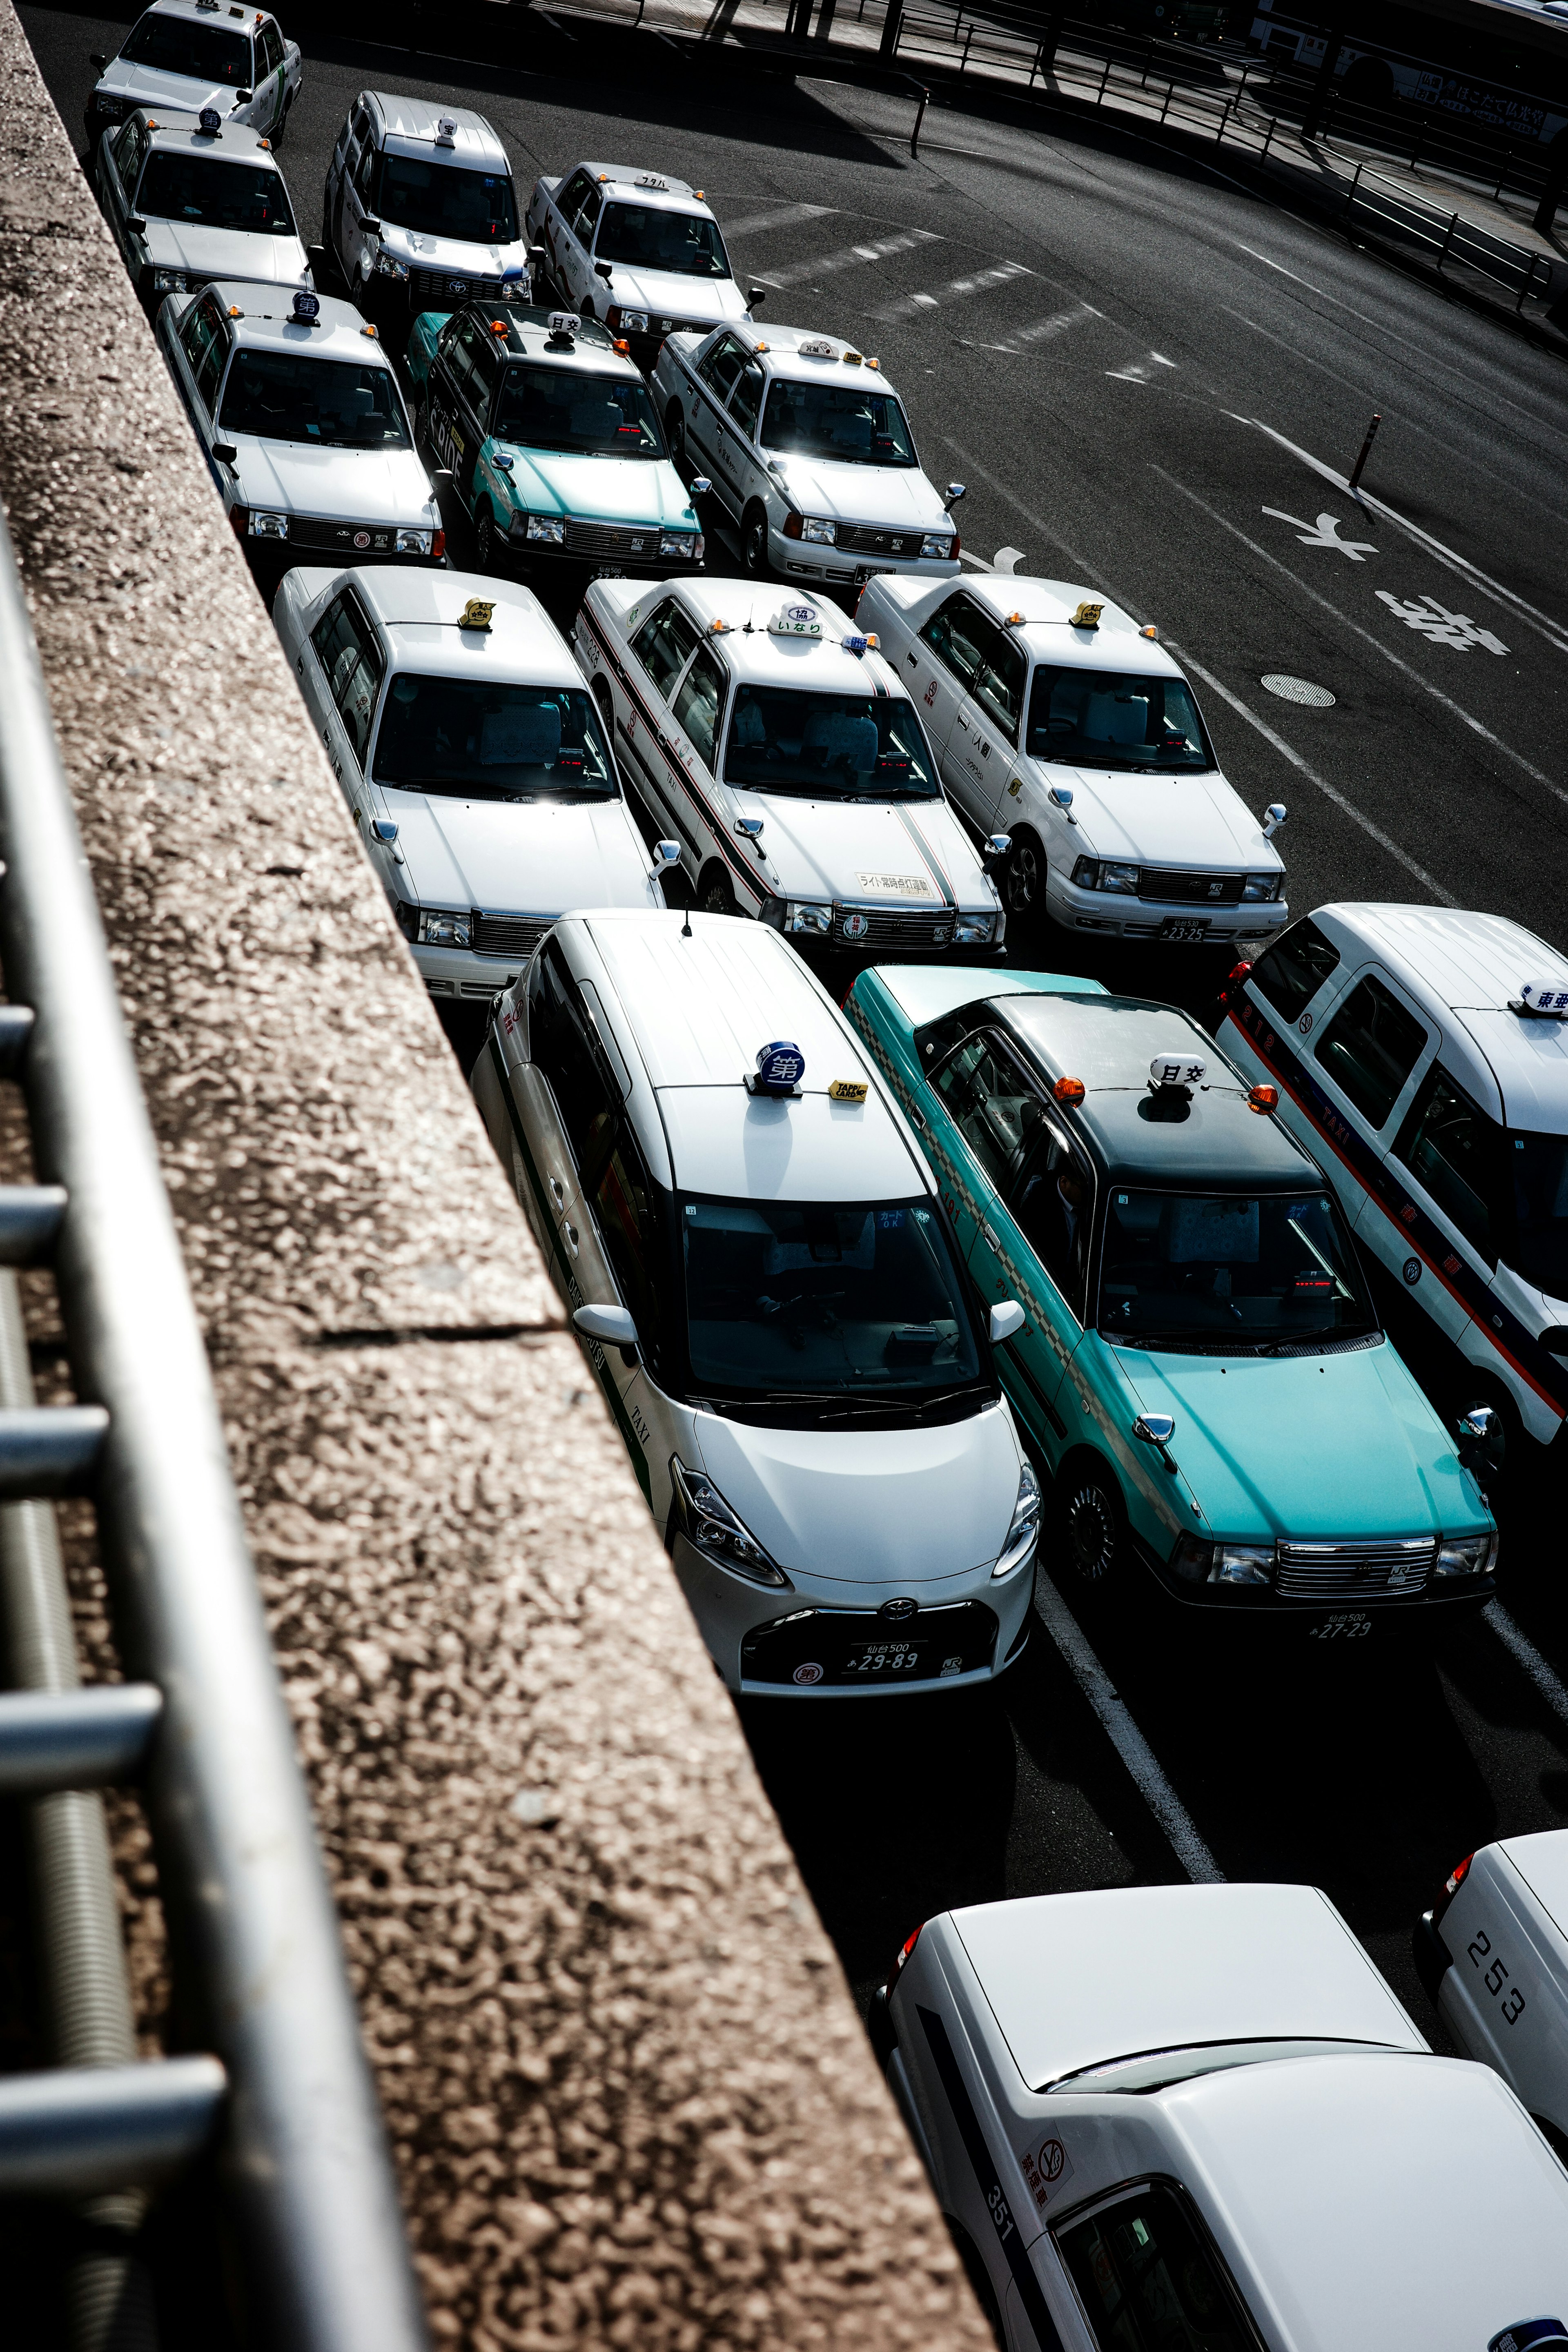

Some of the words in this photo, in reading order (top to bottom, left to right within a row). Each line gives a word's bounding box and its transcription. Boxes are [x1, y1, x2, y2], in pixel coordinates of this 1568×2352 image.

[443, 125, 454, 136] 宝
[642, 177, 666, 187] フタバ
[553, 317, 578, 331] 日交
[796, 609, 807, 619] 協
[778, 621, 820, 633] いなり
[587, 638, 600, 669] 228
[666, 771, 677, 793] TAXI
[861, 876, 928, 891] ライト常時点灯運動
[852, 916, 860, 931] 稲荷
[1168, 927, 1204, 940] 23-25
[1537, 992, 1568, 1009] 東亜
[1242, 1005, 1274, 1054] 212
[1160, 1065, 1204, 1082] 日交
[1323, 1106, 1350, 1145] TAXI
[880, 1211, 903, 1220] カード
[631, 1405, 650, 1445] TAXI
[1392, 1566, 1408, 1576] JR
[1309, 1627, 1318, 1636] あ
[1318, 1622, 1372, 1639] 27-29
[847, 1659, 857, 1668] あ
[858, 1653, 918, 1670] 29-89
[944, 1658, 962, 1667] JR
[1467, 1930, 1526, 2025] 253
[1022, 2153, 1048, 2207] 禁煙車
[988, 2185, 1014, 2241] 351
